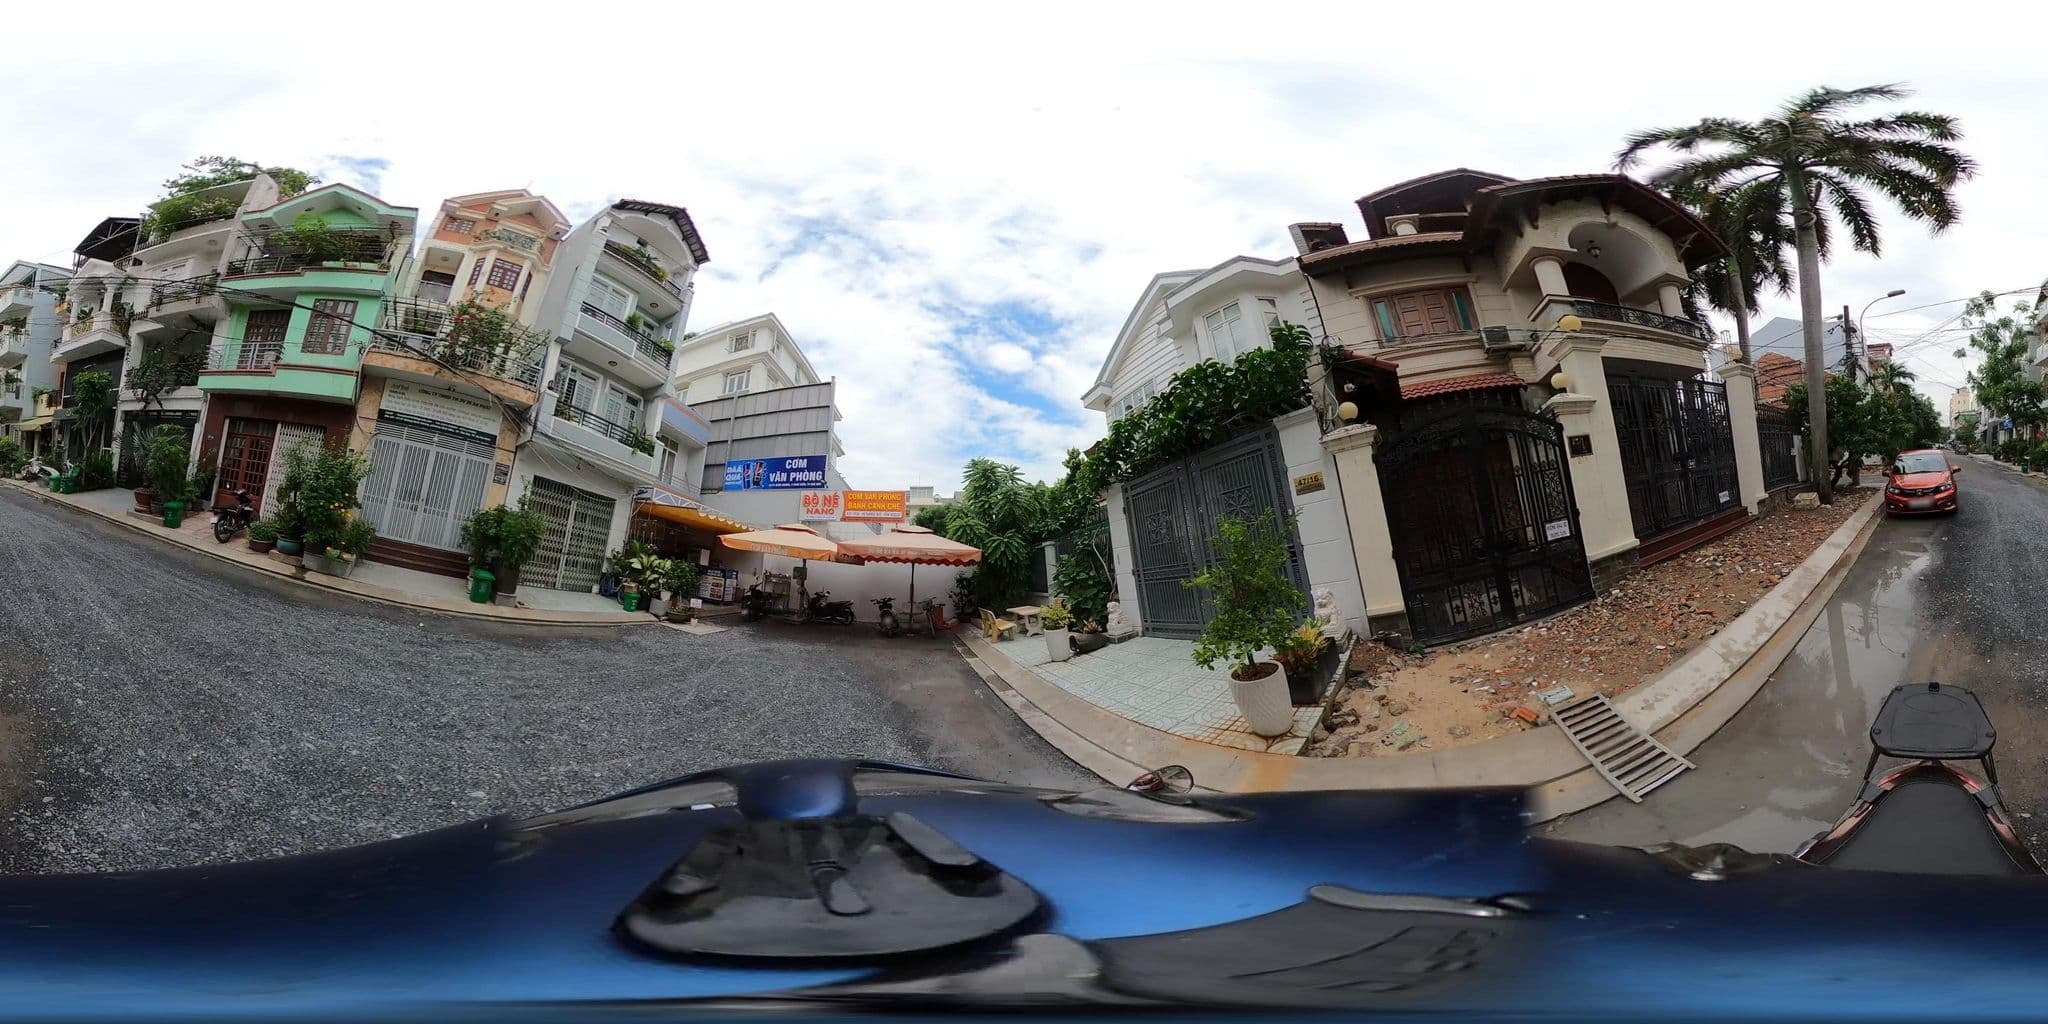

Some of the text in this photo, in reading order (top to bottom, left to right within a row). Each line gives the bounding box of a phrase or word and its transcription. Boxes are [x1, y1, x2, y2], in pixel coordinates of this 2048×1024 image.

[785, 458, 807, 469] CƠM
[770, 470, 823, 482] VĂN PHÒNG
